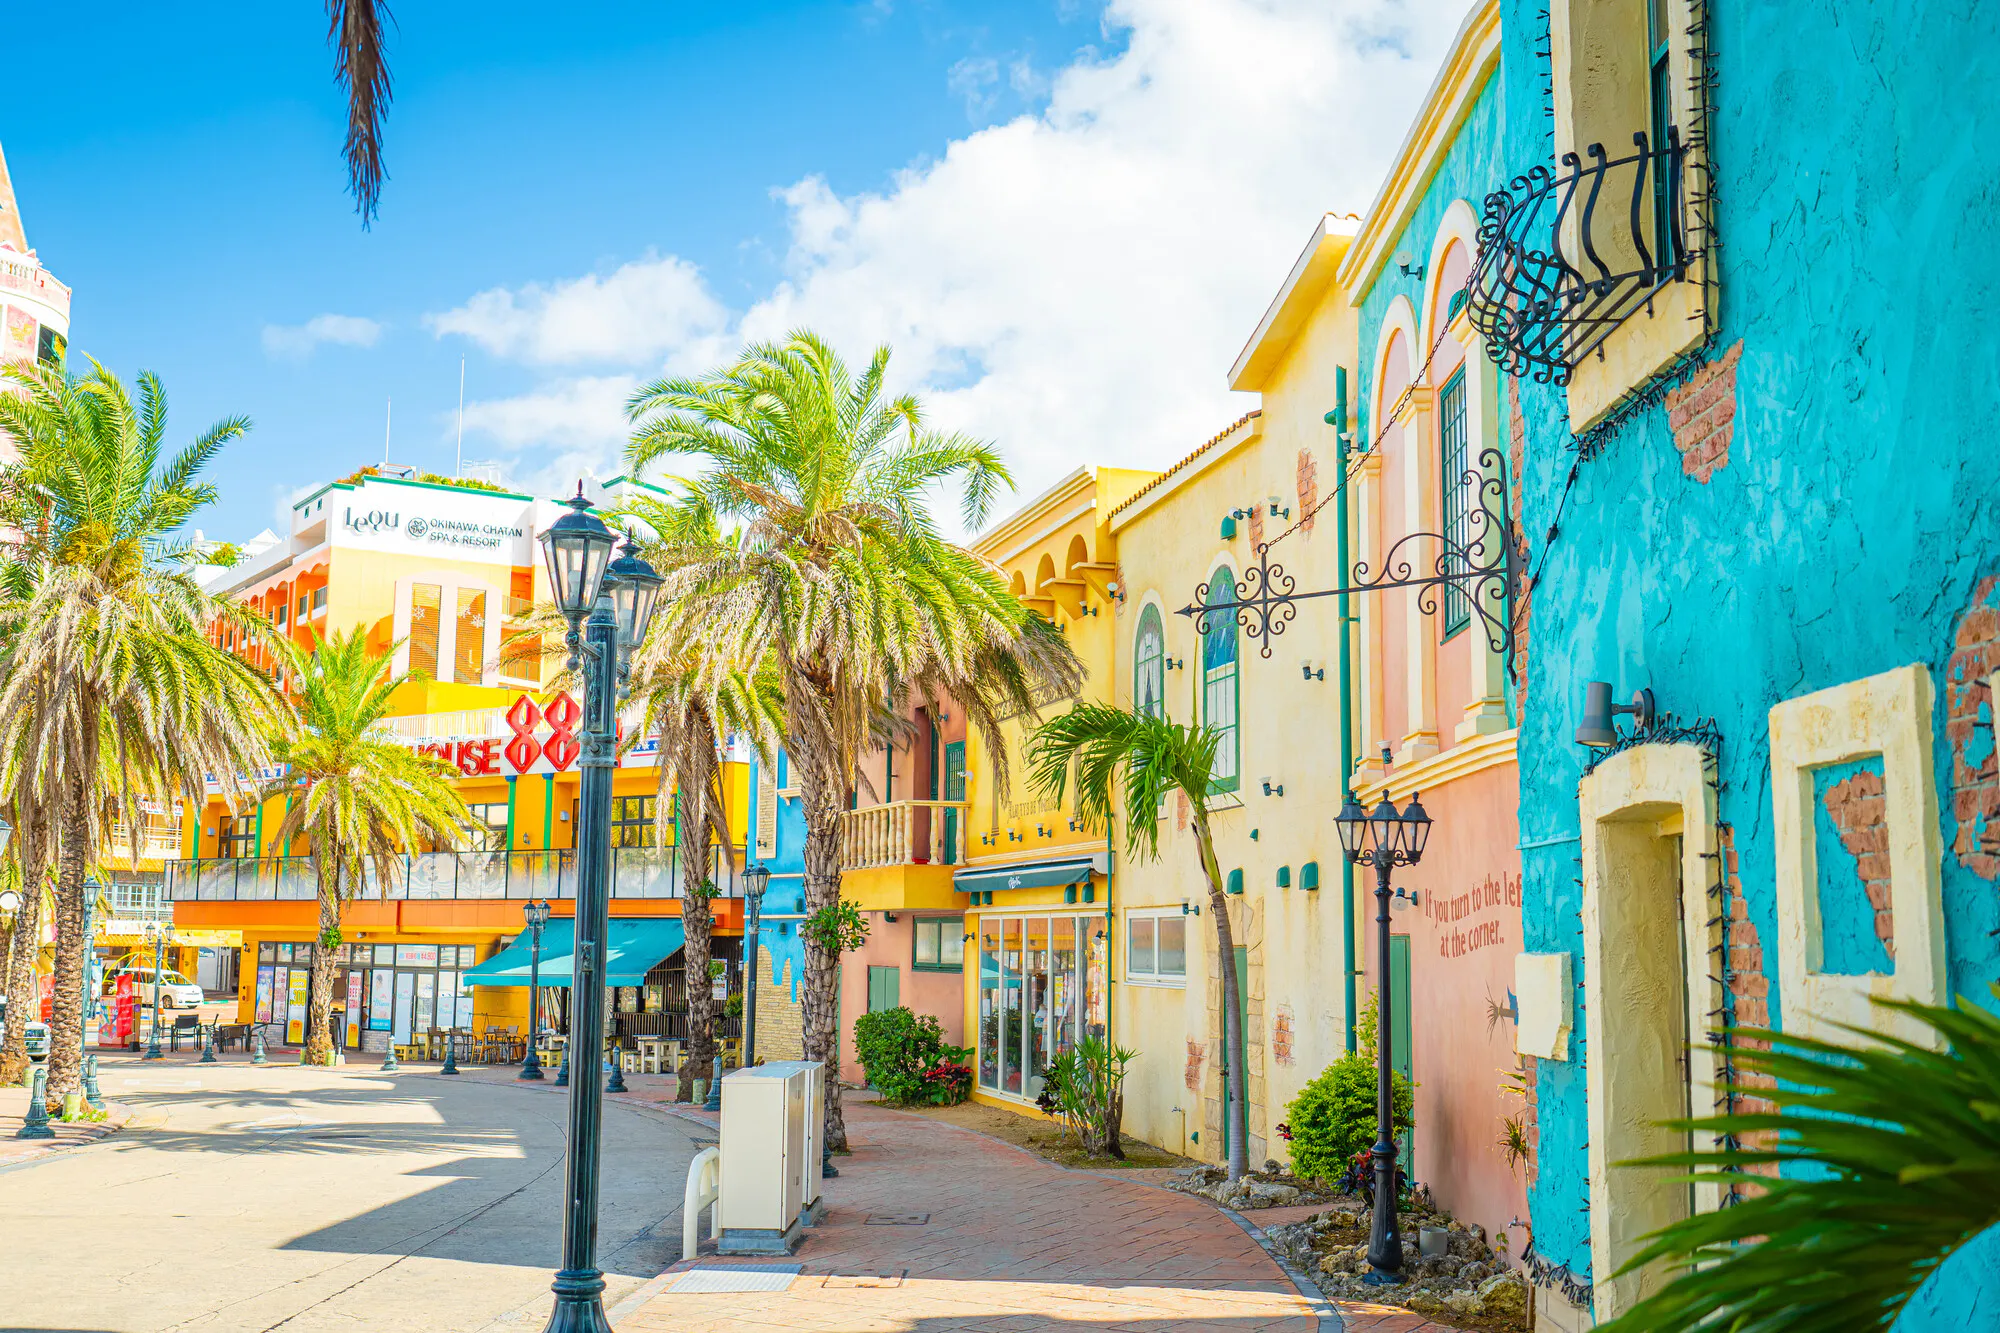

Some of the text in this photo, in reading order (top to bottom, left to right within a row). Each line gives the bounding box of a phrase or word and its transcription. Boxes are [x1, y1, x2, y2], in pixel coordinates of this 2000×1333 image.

[430, 518, 523, 538] OKINAWA CHATAN
[430, 532, 501, 549] SPA & RESORT
[504, 690, 581, 774] 88
[1425, 870, 1522, 929] If you turn to the lef
[1440, 931, 1449, 958] at
[1451, 926, 1466, 958] the
